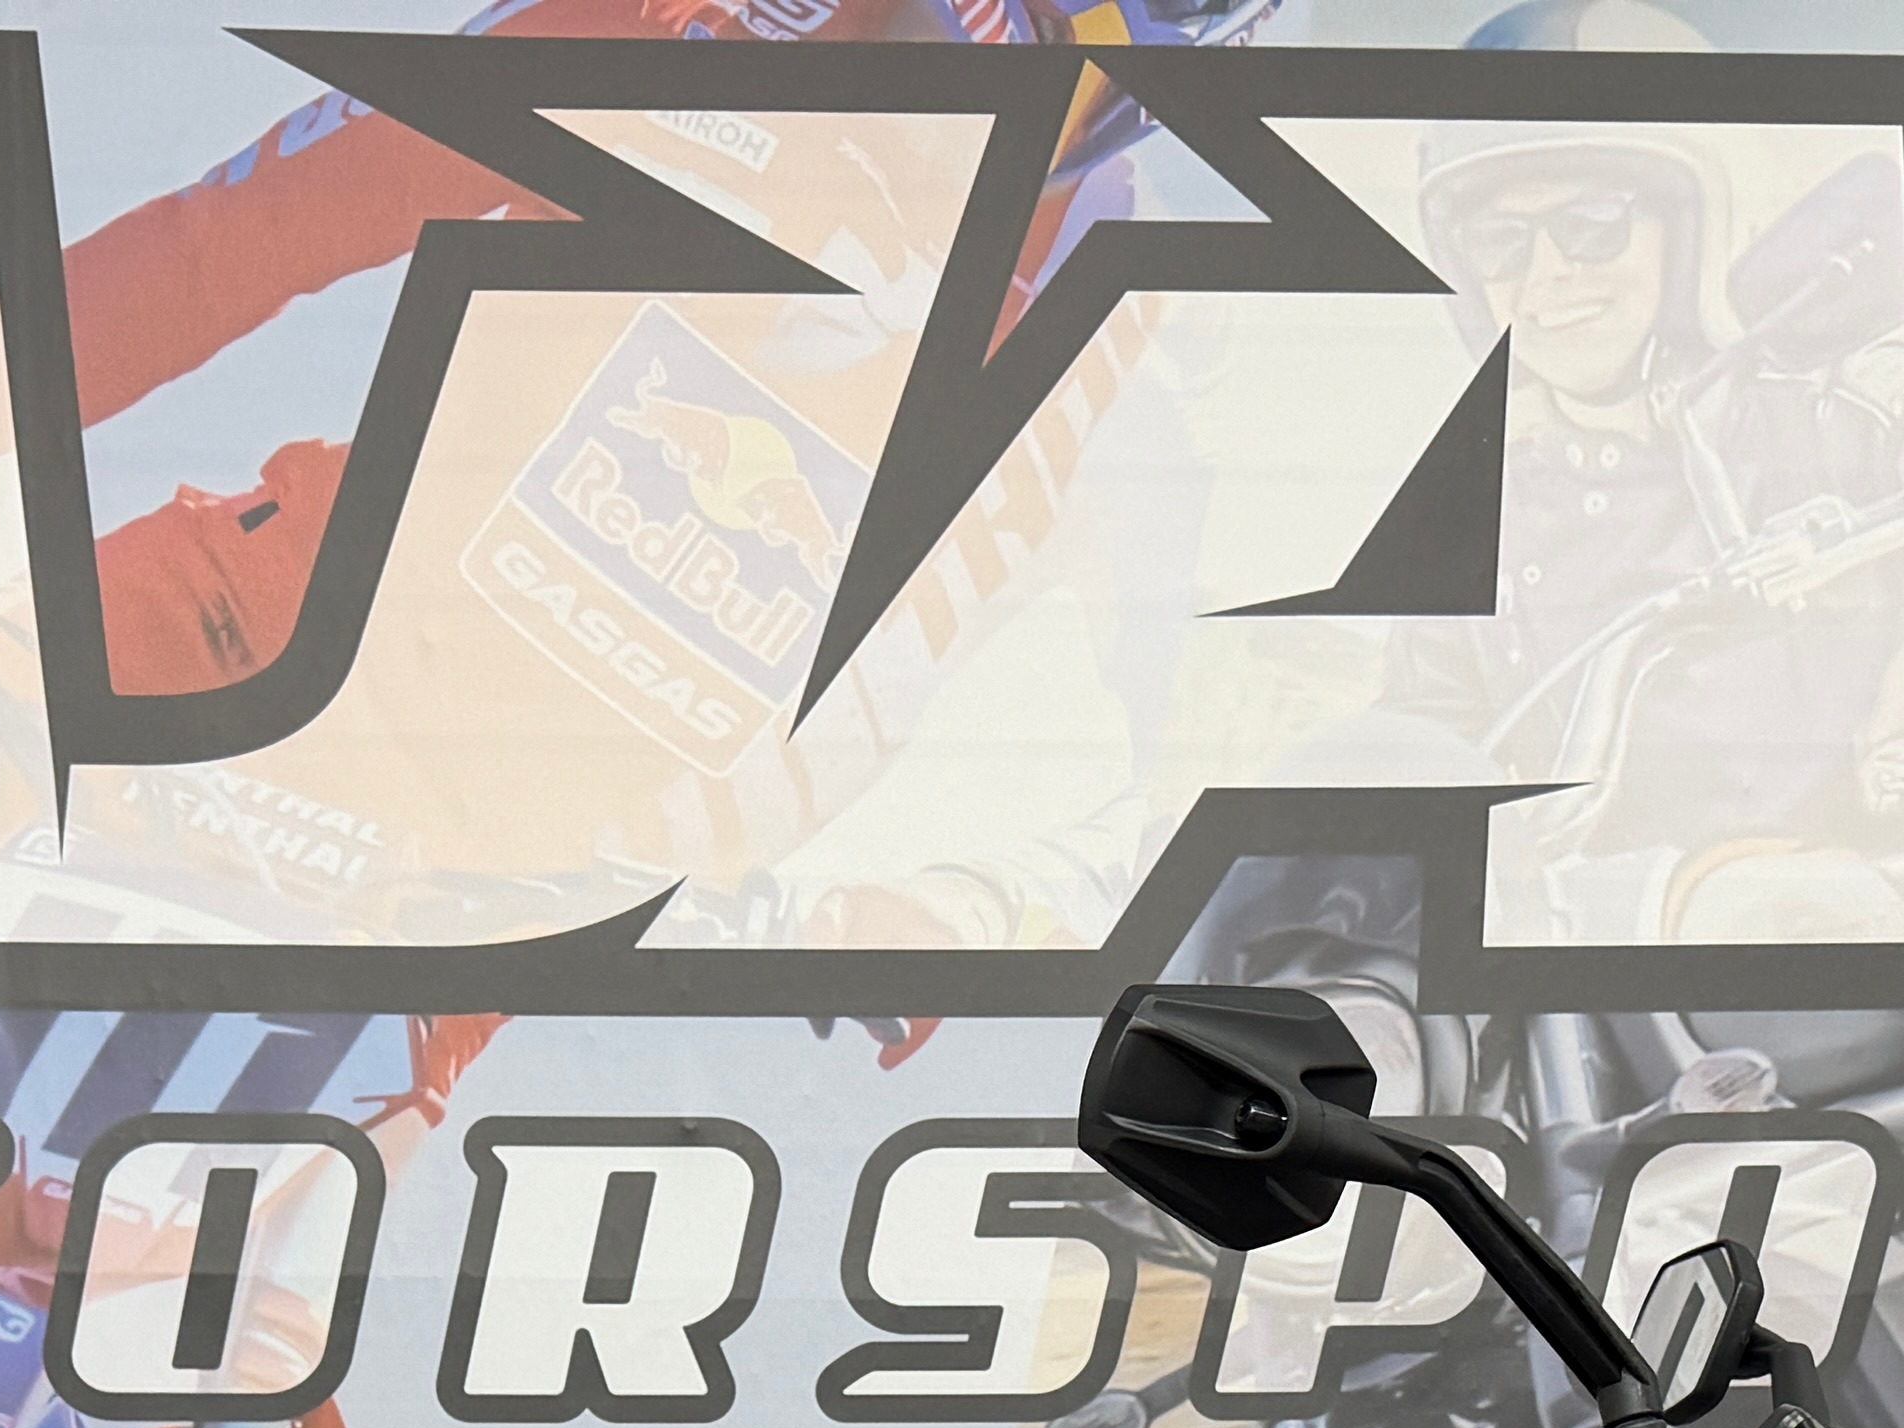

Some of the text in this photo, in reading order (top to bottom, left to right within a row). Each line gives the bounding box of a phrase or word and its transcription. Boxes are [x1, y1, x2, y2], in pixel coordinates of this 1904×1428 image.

[491, 541, 742, 740] GASGAS
[551, 436, 816, 668] Red Bull
